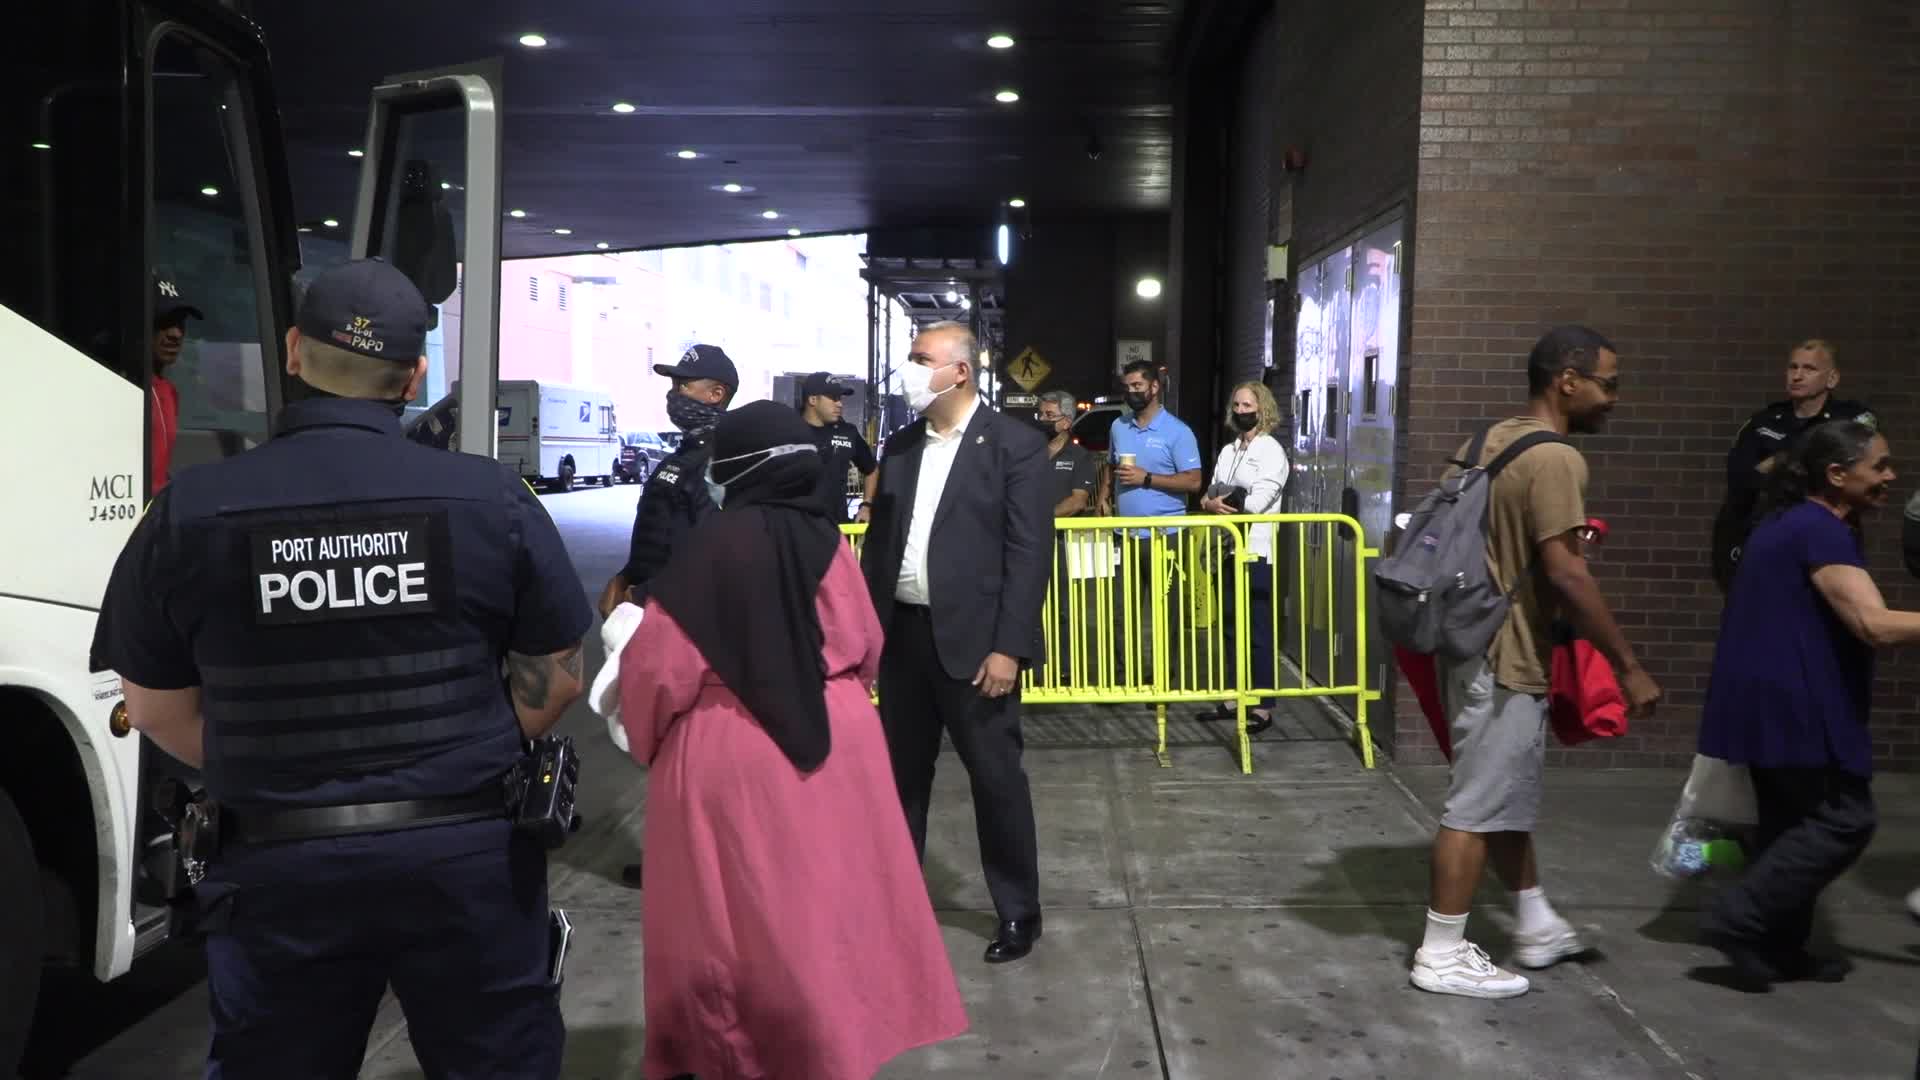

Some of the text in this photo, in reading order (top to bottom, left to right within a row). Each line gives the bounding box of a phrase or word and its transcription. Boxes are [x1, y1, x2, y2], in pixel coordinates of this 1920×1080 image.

[354, 316, 371, 329] 37
[352, 336, 384, 352] PAPD
[831, 439, 852, 448] POLICE
[89, 474, 134, 500] MCI
[89, 504, 136, 521] J4500
[271, 530, 409, 564] PORT AUTHORITY
[259, 562, 428, 614] POLICE
